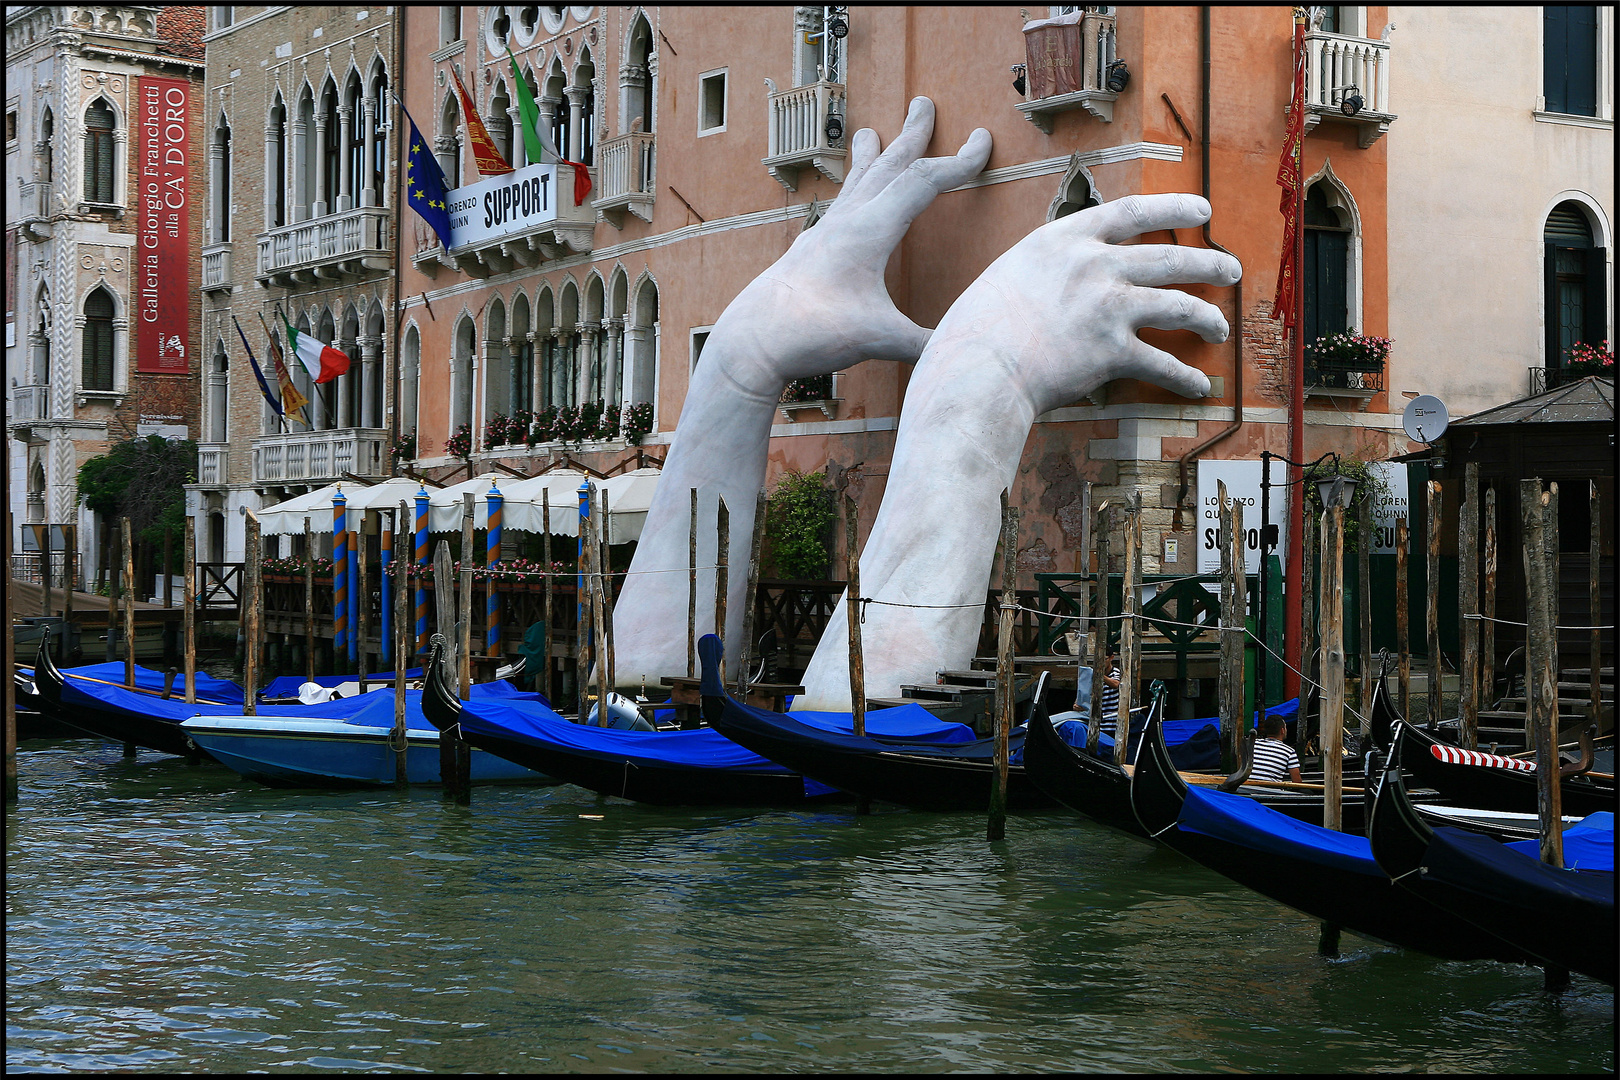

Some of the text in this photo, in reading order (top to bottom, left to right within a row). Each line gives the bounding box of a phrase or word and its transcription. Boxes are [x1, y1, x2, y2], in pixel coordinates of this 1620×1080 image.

[164, 88, 185, 238] alla CA' D'ORO
[143, 86, 163, 322] Galleria Giorgio Franchetti
[484, 173, 550, 228] SUPPORT
[1205, 497, 1255, 506] LOENZO
[1375, 497, 1407, 506] LOREN
